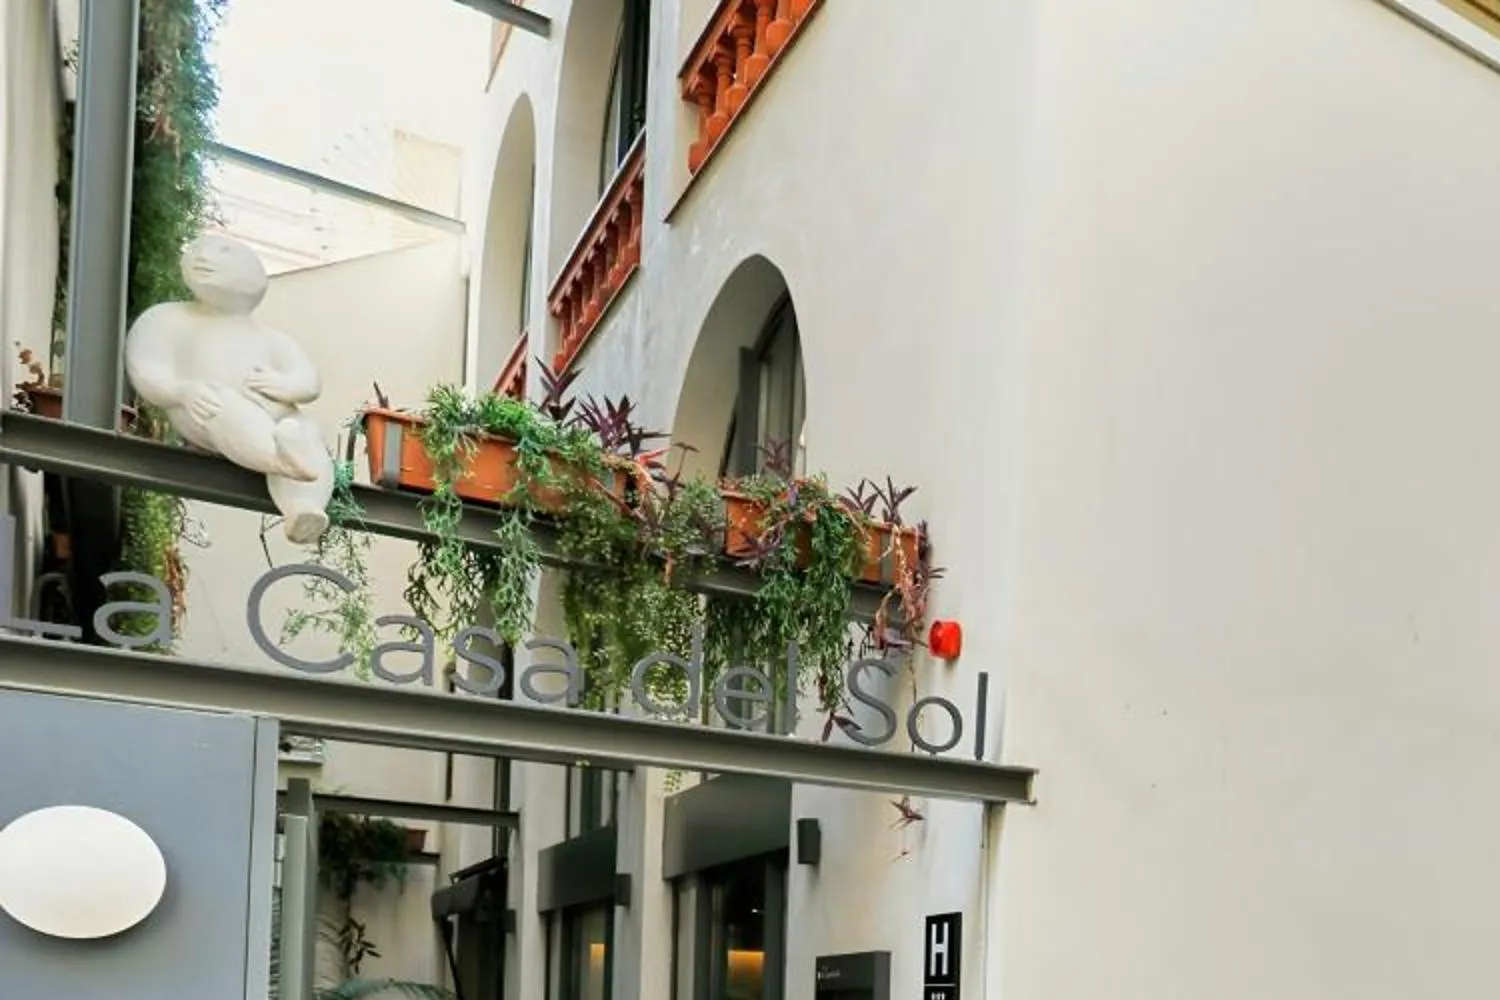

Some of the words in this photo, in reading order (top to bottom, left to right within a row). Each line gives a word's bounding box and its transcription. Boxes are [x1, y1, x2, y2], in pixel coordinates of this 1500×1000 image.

[0, 514, 174, 646] La
[247, 563, 586, 708] Casa
[631, 622, 799, 735] del
[840, 658, 989, 762] Sol
[929, 921, 950, 977] H
